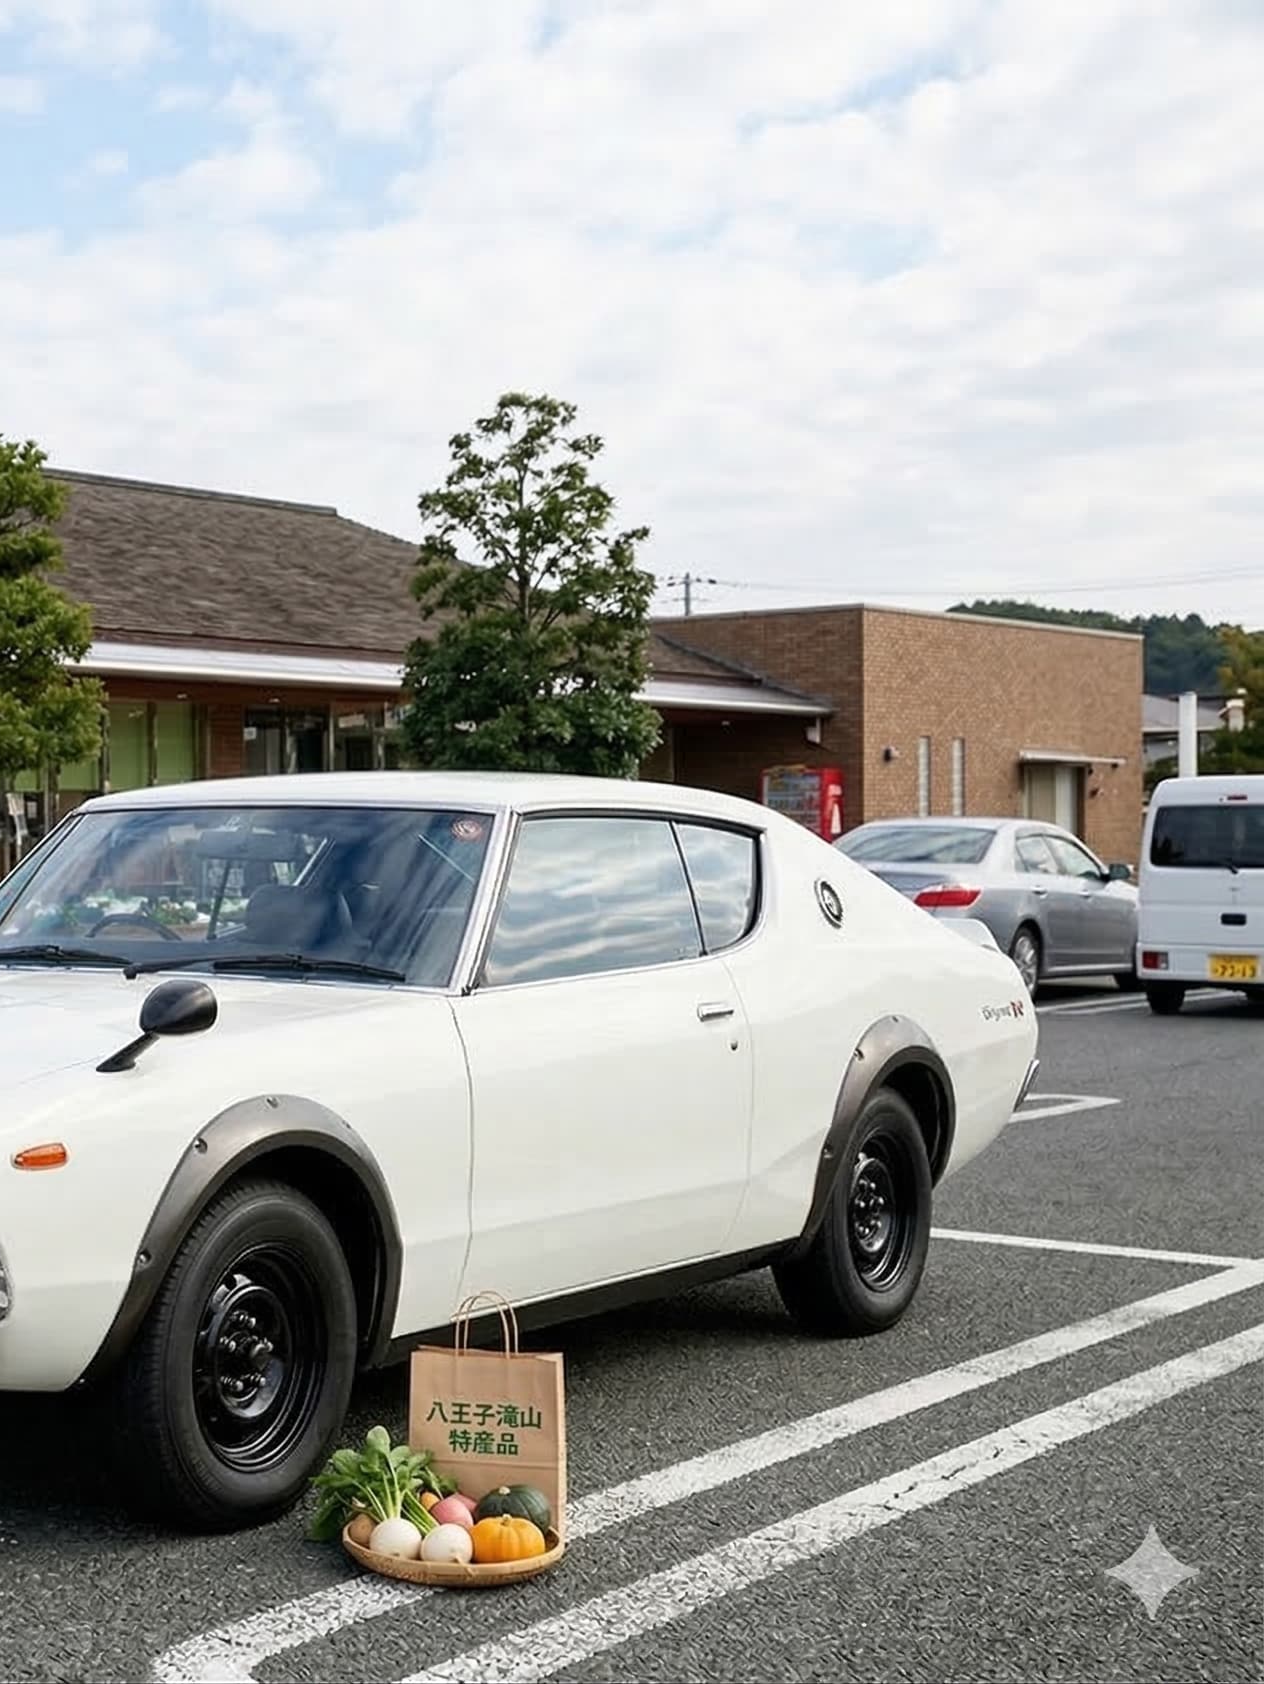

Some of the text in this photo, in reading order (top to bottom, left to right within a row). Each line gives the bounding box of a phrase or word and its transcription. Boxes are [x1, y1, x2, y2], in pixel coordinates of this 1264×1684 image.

[426, 1401, 542, 1429] 八王子滝山
[449, 1429, 519, 1456] 特産品
